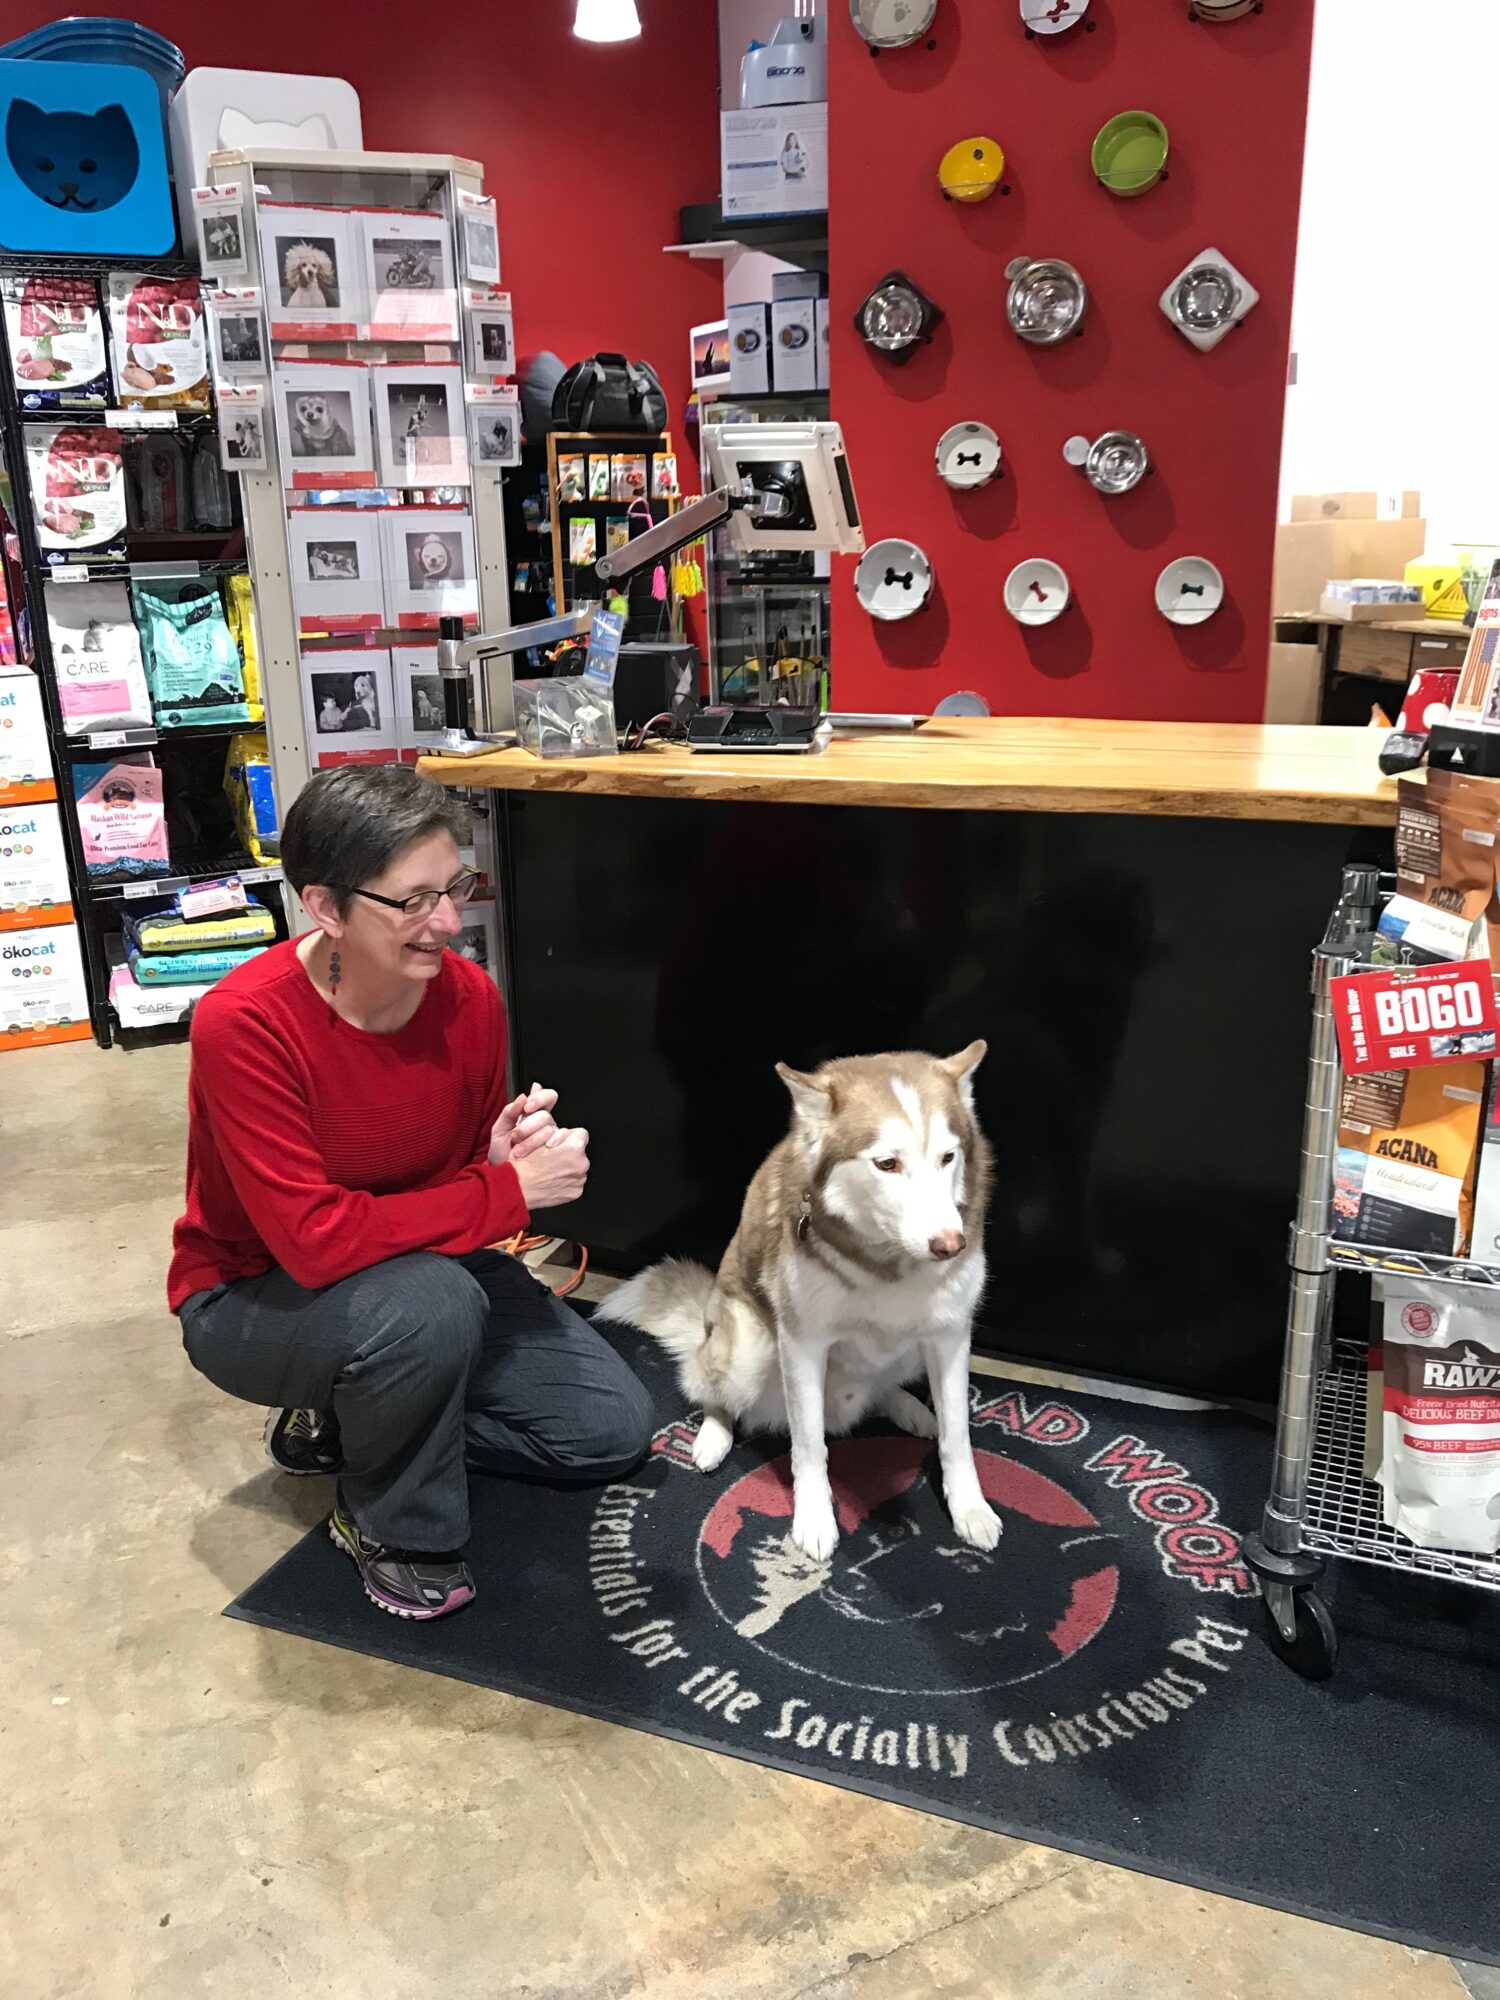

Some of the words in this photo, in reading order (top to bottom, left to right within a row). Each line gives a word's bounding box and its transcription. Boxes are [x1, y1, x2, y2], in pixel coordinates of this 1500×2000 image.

[137, 302, 196, 331] N&D
[56, 457, 117, 483] N&D
[66, 660, 110, 676] CARE
[0, 692, 16, 706] at
[3, 941, 56, 959] ökocat
[137, 1002, 174, 1015] CARE
[1375, 981, 1484, 1036] BOGO
[1388, 1045, 1417, 1059] SALE
[1376, 1138, 1438, 1169] ACANA
[1402, 1405, 1453, 1420] DELICIOUS
[1455, 1409, 1485, 1420] BEEF
[1446, 1400, 1467, 1408] Dried
[1433, 1441, 1462, 1451] BEEF
[967, 1384, 1090, 1446] AD
[1084, 1435, 1263, 1599] WOOF
[608, 1619, 691, 1668] for
[677, 1665, 762, 1724] the
[764, 1699, 971, 1778] Socially
[993, 1667, 1207, 1765] Conscious
[1166, 1615, 1250, 1672] Pet
